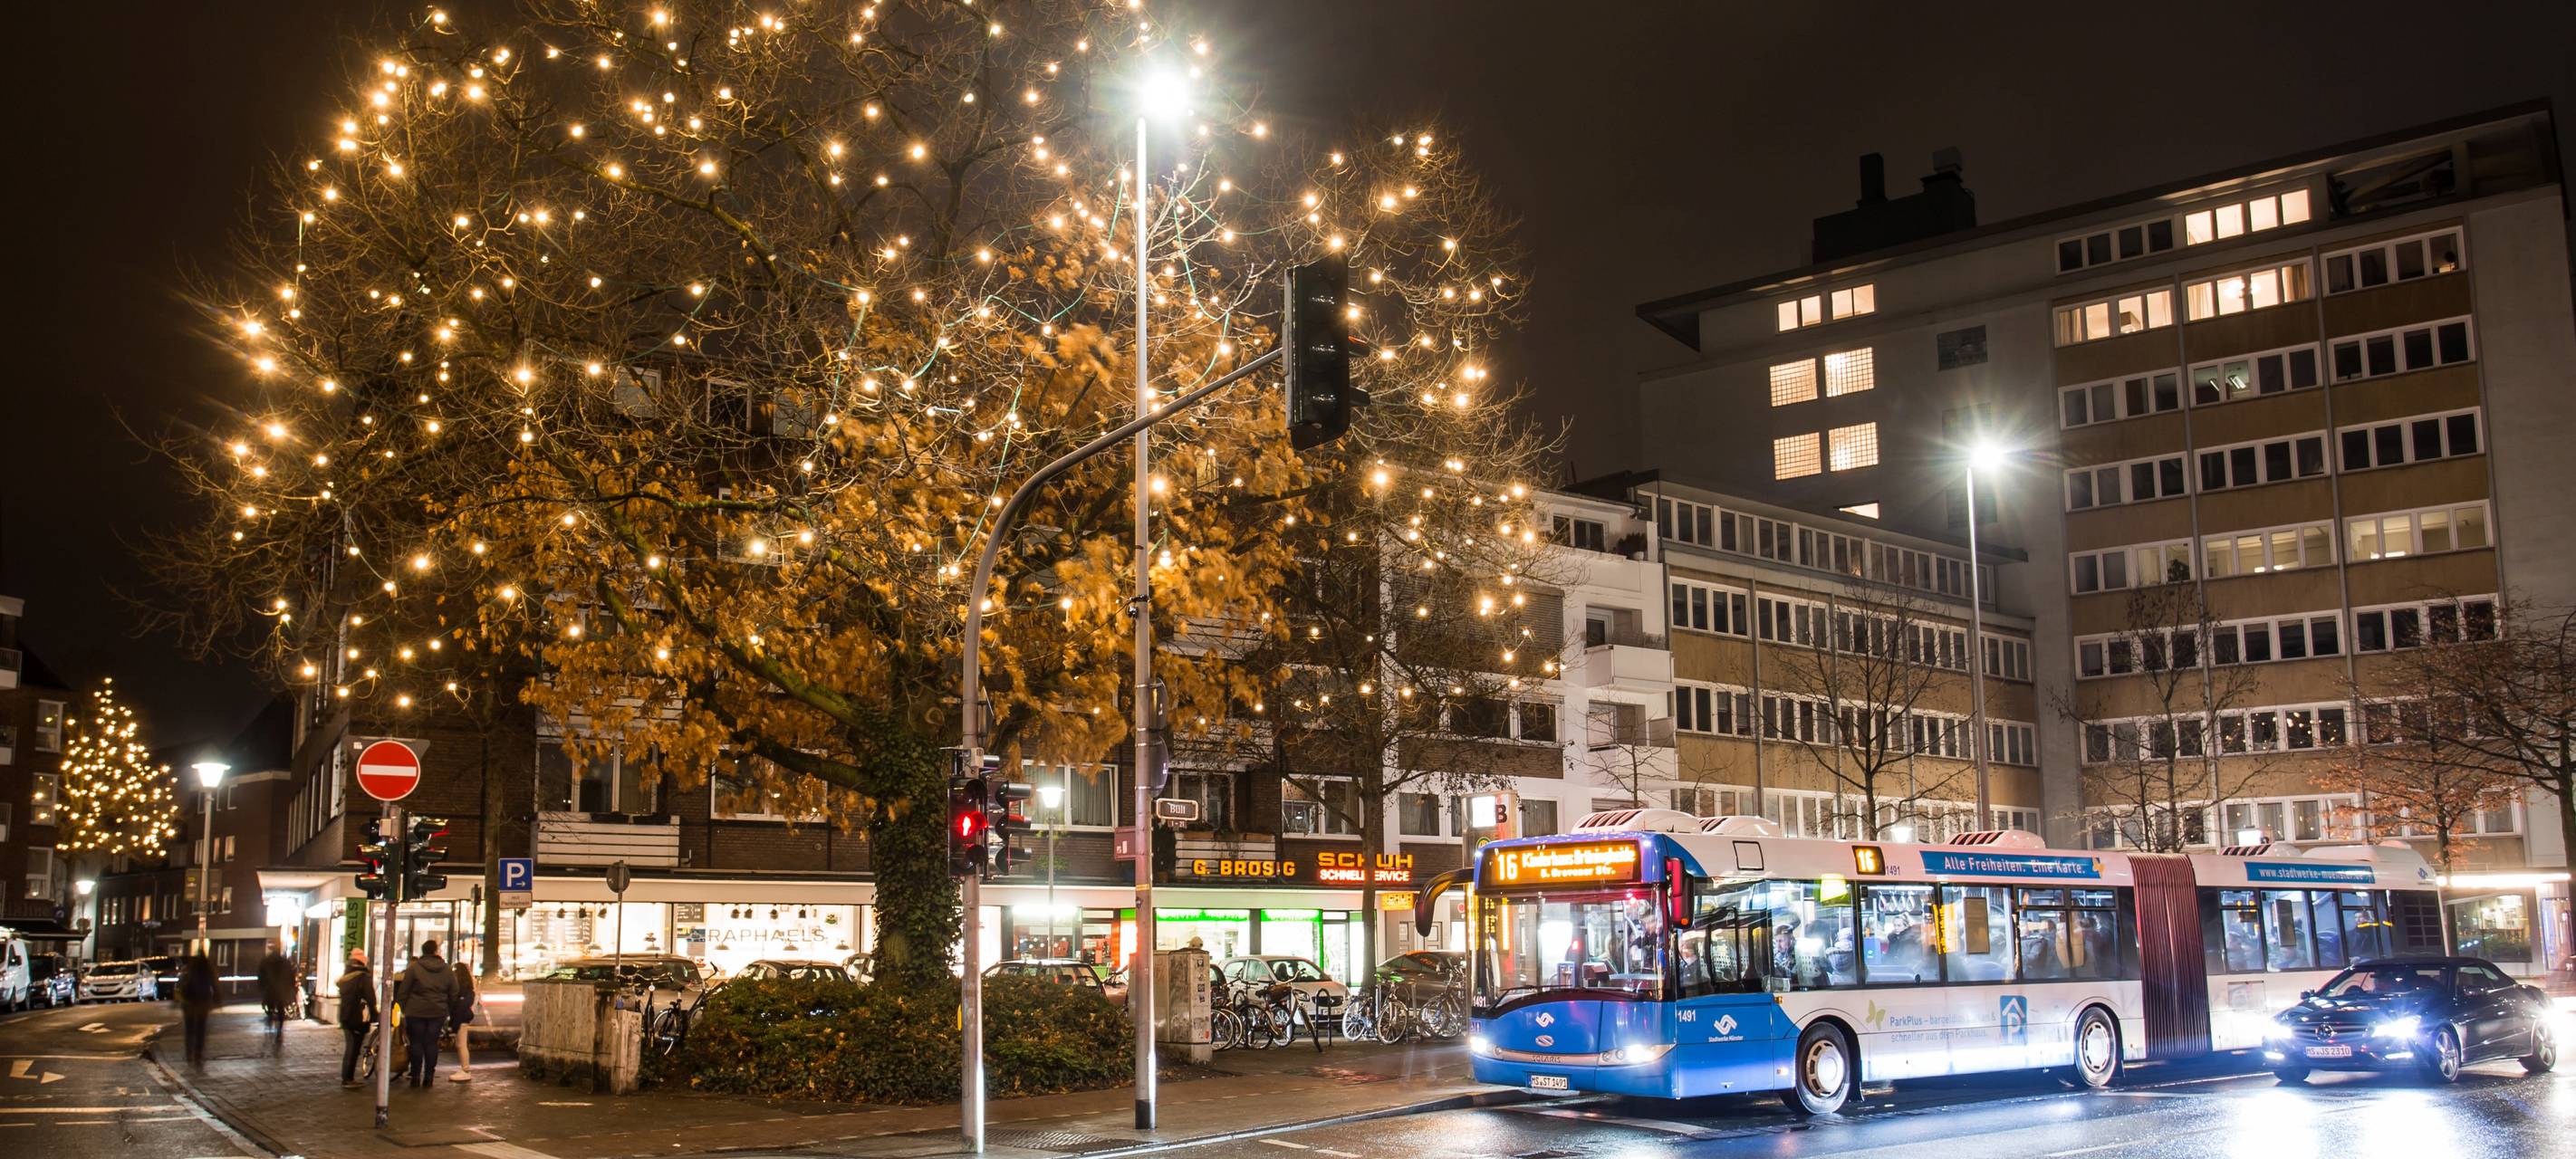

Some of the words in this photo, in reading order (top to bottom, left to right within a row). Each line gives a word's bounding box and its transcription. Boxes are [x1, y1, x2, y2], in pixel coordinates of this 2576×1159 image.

[1496, 854, 1518, 880] 16
[1857, 850, 1876, 872] 16
[1944, 857, 1966, 870] Alle
[1968, 857, 2025, 873] Freiheiten.
[2032, 859, 2053, 873] Eine
[2055, 860, 2086, 875] Karte.
[1193, 859, 1211, 876] G.
[1596, 866, 1617, 876] Str.
[1886, 866, 1900, 876] 1491
[507, 862, 525, 887] P
[708, 929, 825, 943] RAPHAELS
[1473, 996, 1486, 1007] 1491
[1677, 1010, 1696, 1022] 1491
[1890, 1015, 1923, 1027] ParkPlus
[1532, 1055, 1561, 1063] SOLARIS
[1552, 1078, 1567, 1088] 1491
